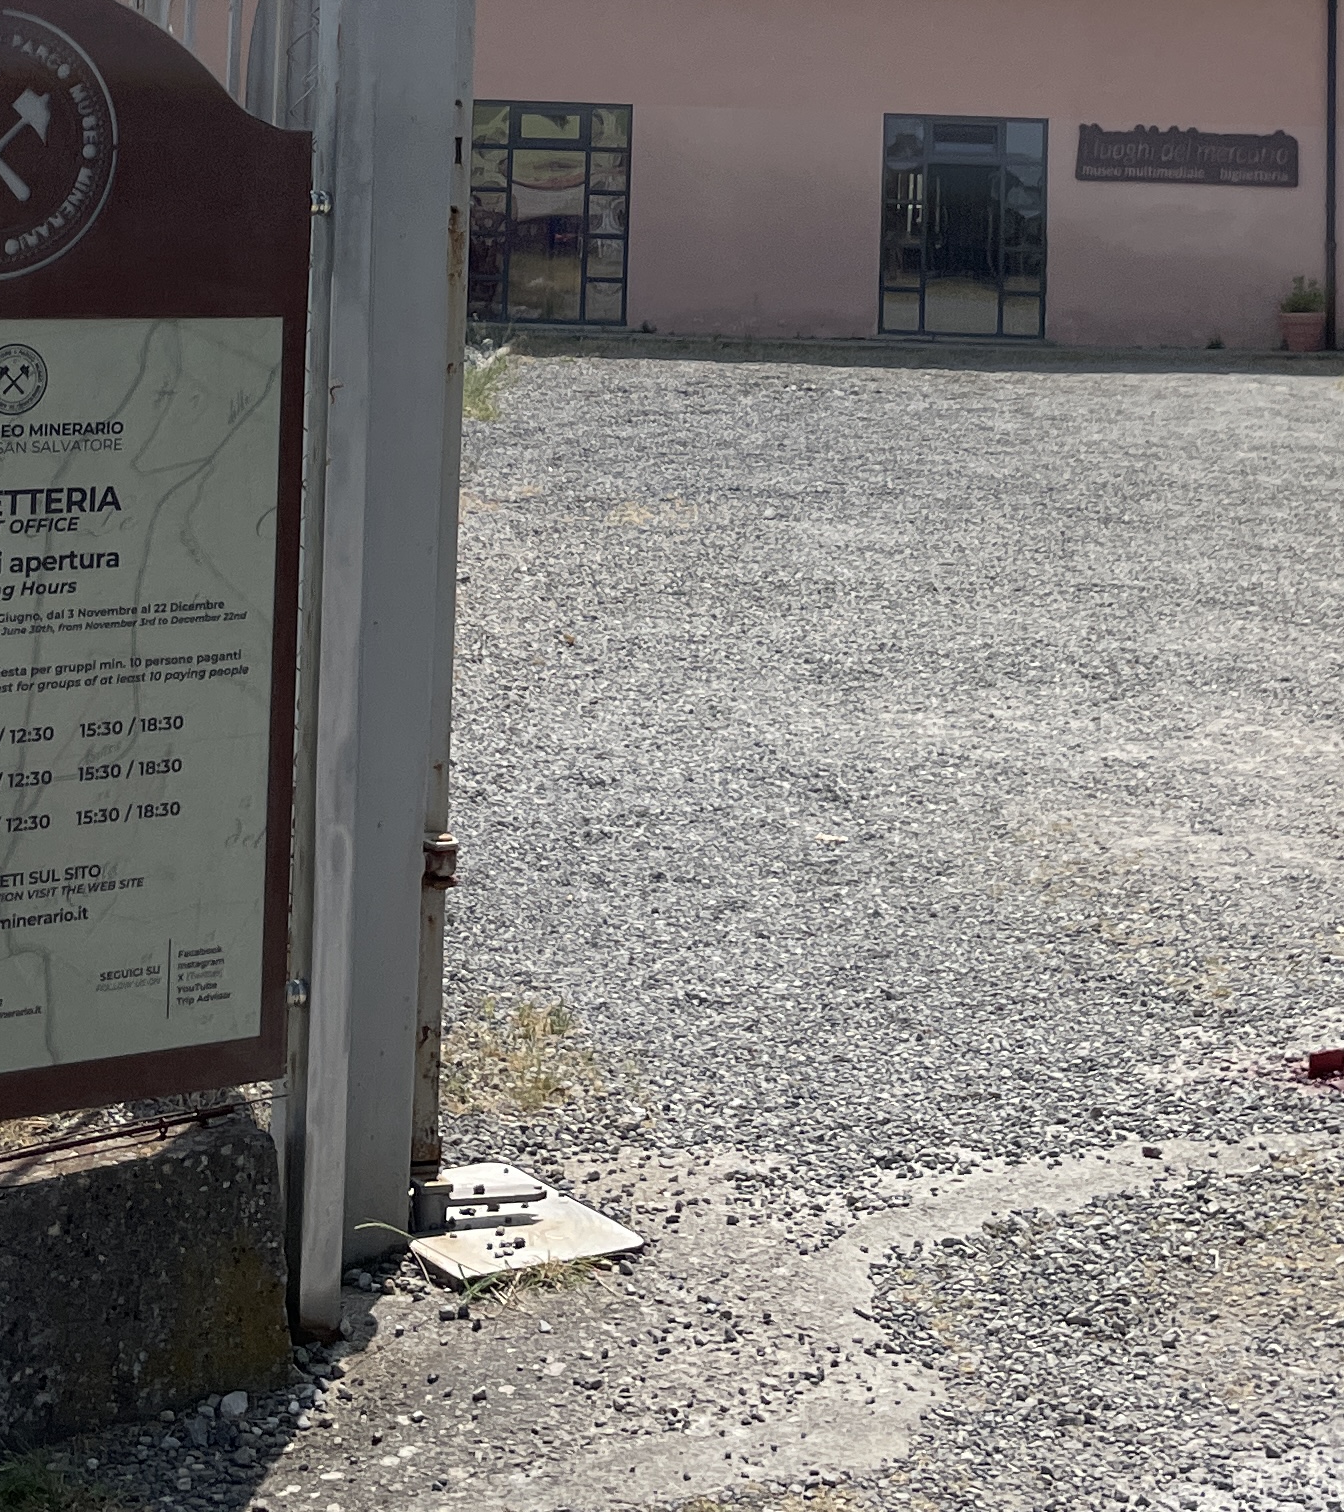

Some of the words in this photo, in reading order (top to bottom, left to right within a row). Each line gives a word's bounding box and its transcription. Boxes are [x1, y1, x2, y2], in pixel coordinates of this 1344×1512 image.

[70, 83, 96, 160] MUSEO
[29, 421, 123, 437] MINERARIO
[31, 438, 123, 453] SALVATORE
[9, 516, 80, 534] OFFICE
[9, 550, 120, 578] apertura
[21, 580, 77, 597] Hours
[46, 610, 65, 621] dal
[67, 610, 74, 619] 3
[77, 605, 137, 619] Novembre
[141, 603, 151, 614] al
[153, 602, 167, 613] 22
[170, 599, 225, 613] Dicembre
[1, 626, 26, 636] June
[57, 621, 83, 633] from
[85, 618, 137, 631] November
[139, 616, 156, 627] 3rd
[158, 615, 168, 625] to
[170, 613, 220, 625] December
[223, 611, 248, 622] 22nd
[30, 665, 52, 678] per
[55, 659, 96, 677] gruppi
[100, 657, 126, 670] min.
[130, 657, 142, 668] 10
[145, 655, 193, 668] persone
[197, 649, 242, 665] paganti
[16, 680, 34, 692] for
[37, 677, 81, 693] groups
[84, 674, 97, 687] of
[100, 674, 112, 685] at
[116, 671, 146, 684] least
[149, 670, 162, 682] 10
[164, 668, 206, 682] paying
[208, 664, 249, 679] people
[9, 726, 55, 745] 12:30
[80, 720, 123, 738] 15:30
[127, 716, 137, 736] /
[140, 715, 184, 734] 18:30
[7, 770, 53, 789] 12:30
[78, 764, 121, 782] 15:30
[126, 759, 135, 780] /
[138, 758, 182, 776] 18:30
[6, 814, 51, 833] 12:30
[76, 807, 120, 826] 15:30
[124, 803, 133, 823] /
[136, 801, 181, 820] 18:30
[28, 868, 61, 885] SUL
[64, 864, 102, 881] SITO
[27, 886, 58, 900] VISIT
[61, 882, 86, 896] THE
[87, 880, 116, 893] WEB
[119, 876, 145, 889] SITE
[99, 967, 143, 981] SEGUICI
[146, 965, 161, 976] SU
